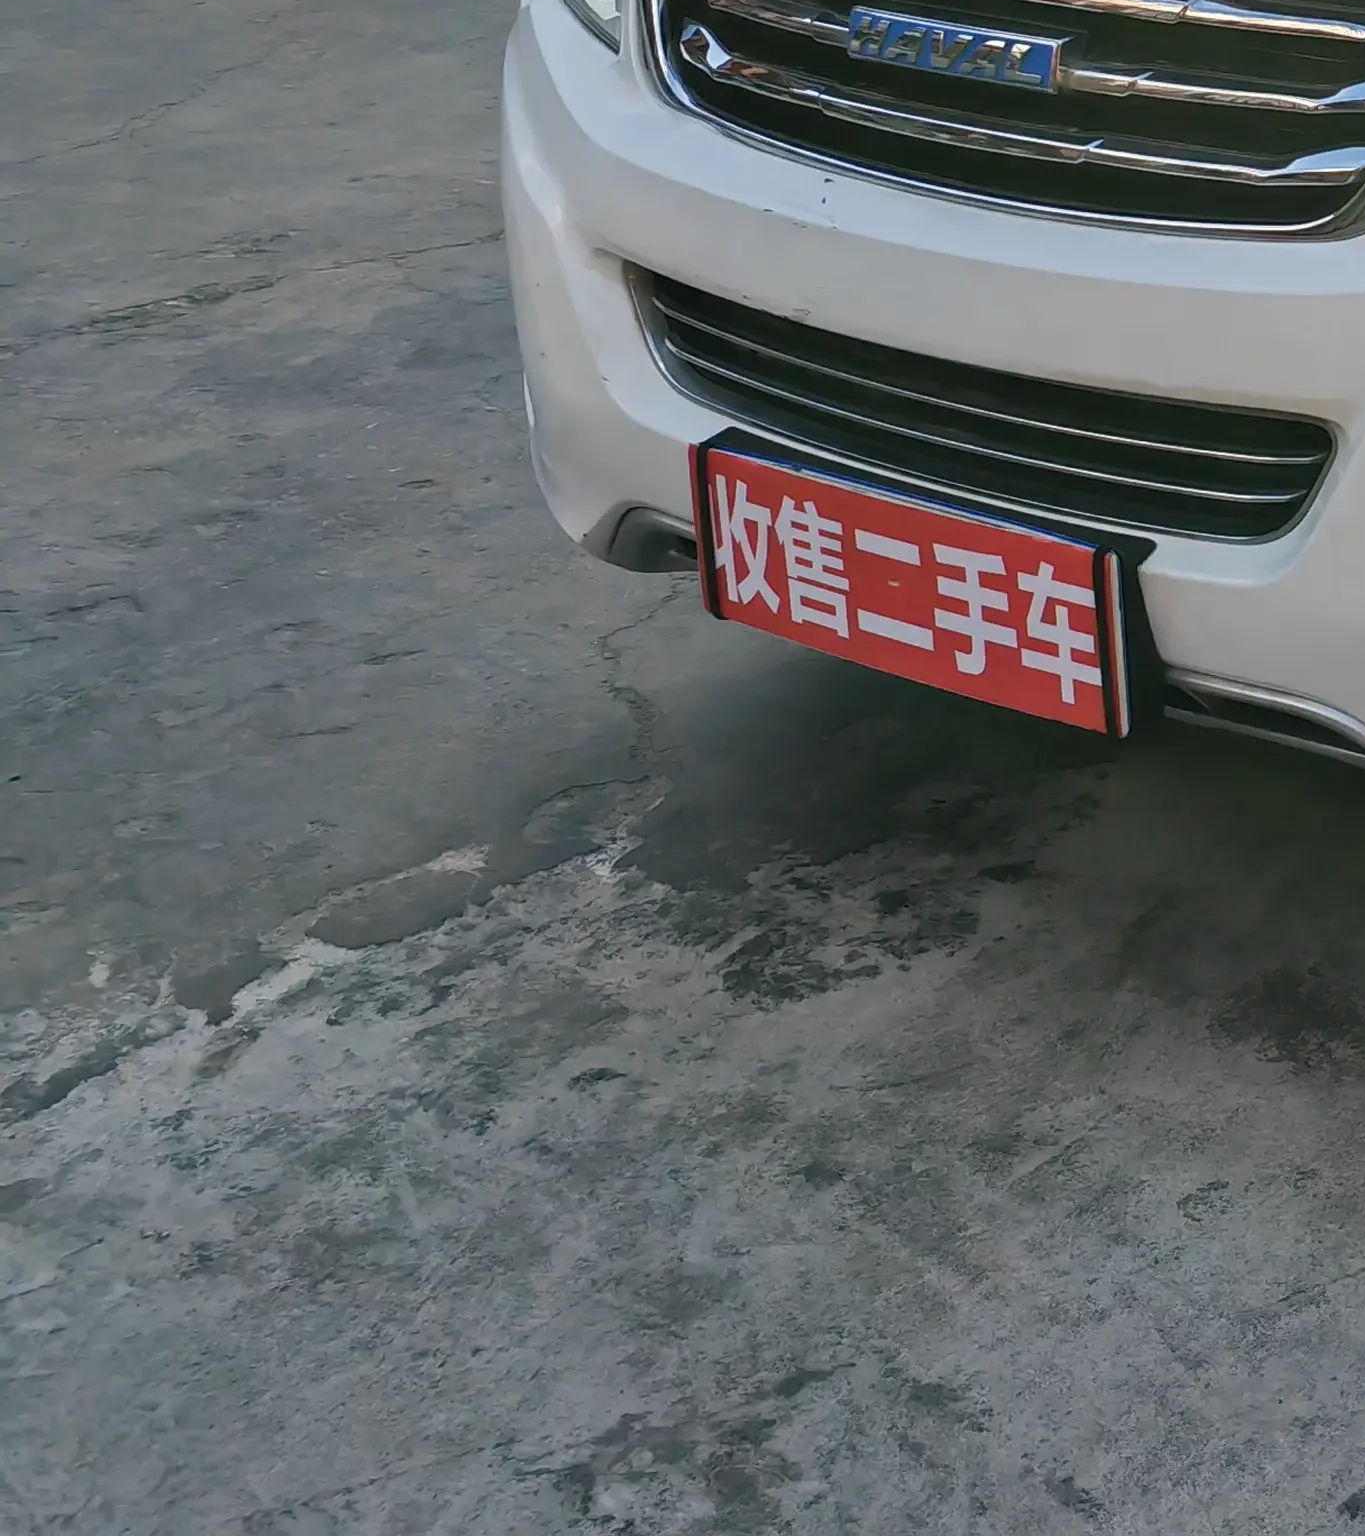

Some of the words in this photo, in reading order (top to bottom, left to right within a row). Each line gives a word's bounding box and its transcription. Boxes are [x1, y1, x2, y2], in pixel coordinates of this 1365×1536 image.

[851, 15, 1044, 86] HAVAL
[707, 472, 1103, 706] 收售二手车
